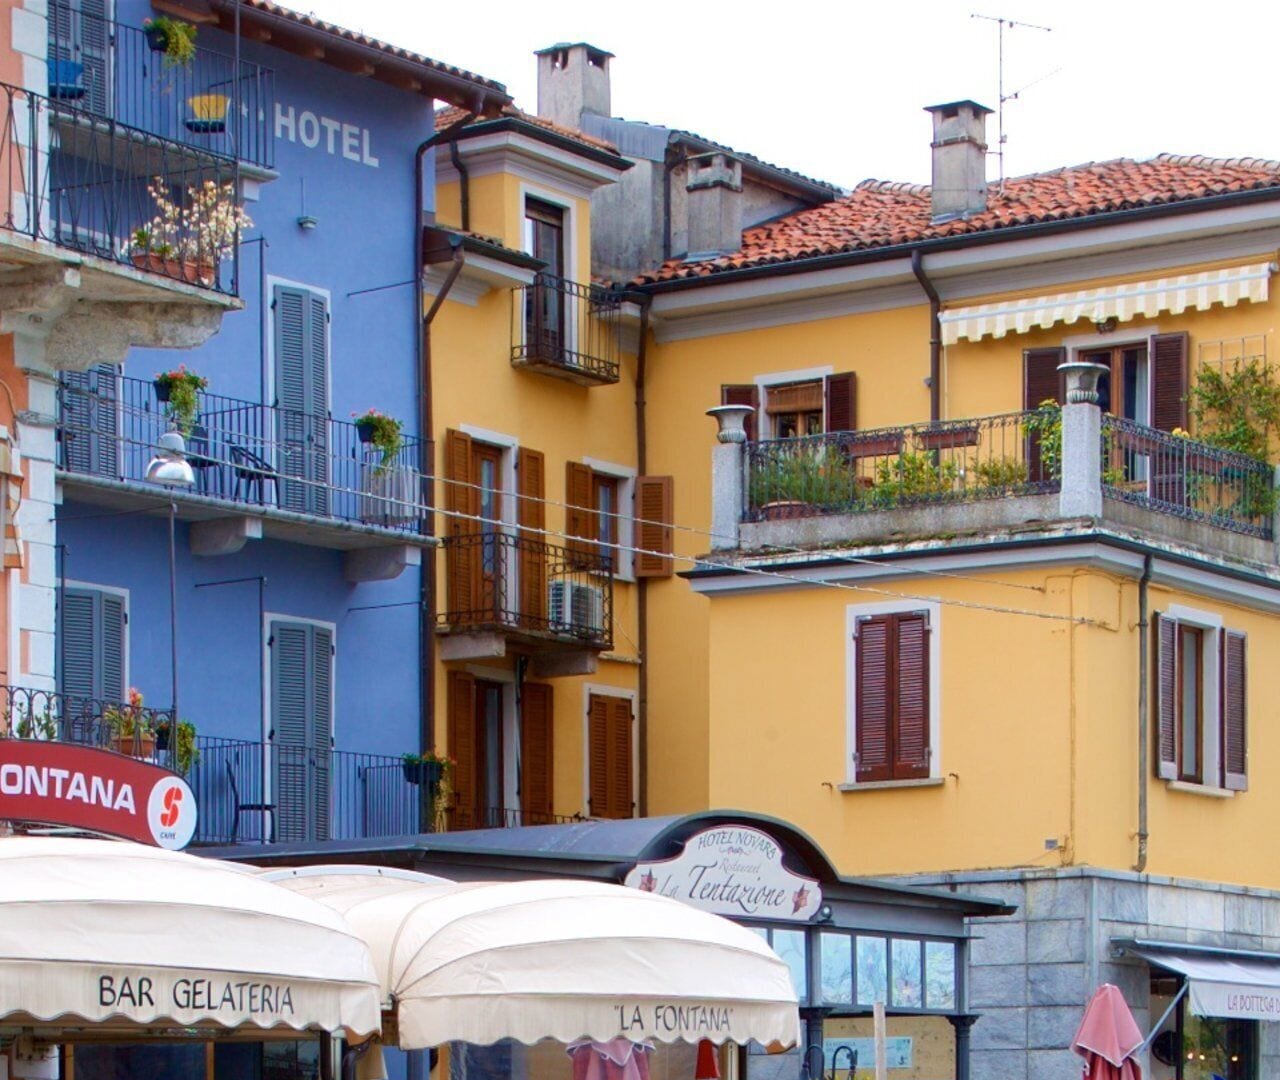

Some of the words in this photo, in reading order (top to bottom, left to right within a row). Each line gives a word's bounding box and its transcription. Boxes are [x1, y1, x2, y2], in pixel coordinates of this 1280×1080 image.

[275, 102, 380, 168] HOTEL
[698, 831, 733, 850] HOTEL
[736, 832, 777, 860] NOVARA
[659, 875, 679, 898] La
[688, 860, 787, 914] Tentazione
[99, 975, 154, 1007] BAR
[172, 978, 295, 1015] GELATERIA
[1227, 993, 1238, 1011] LA
[1240, 994, 1274, 1013] BOTTEGA
